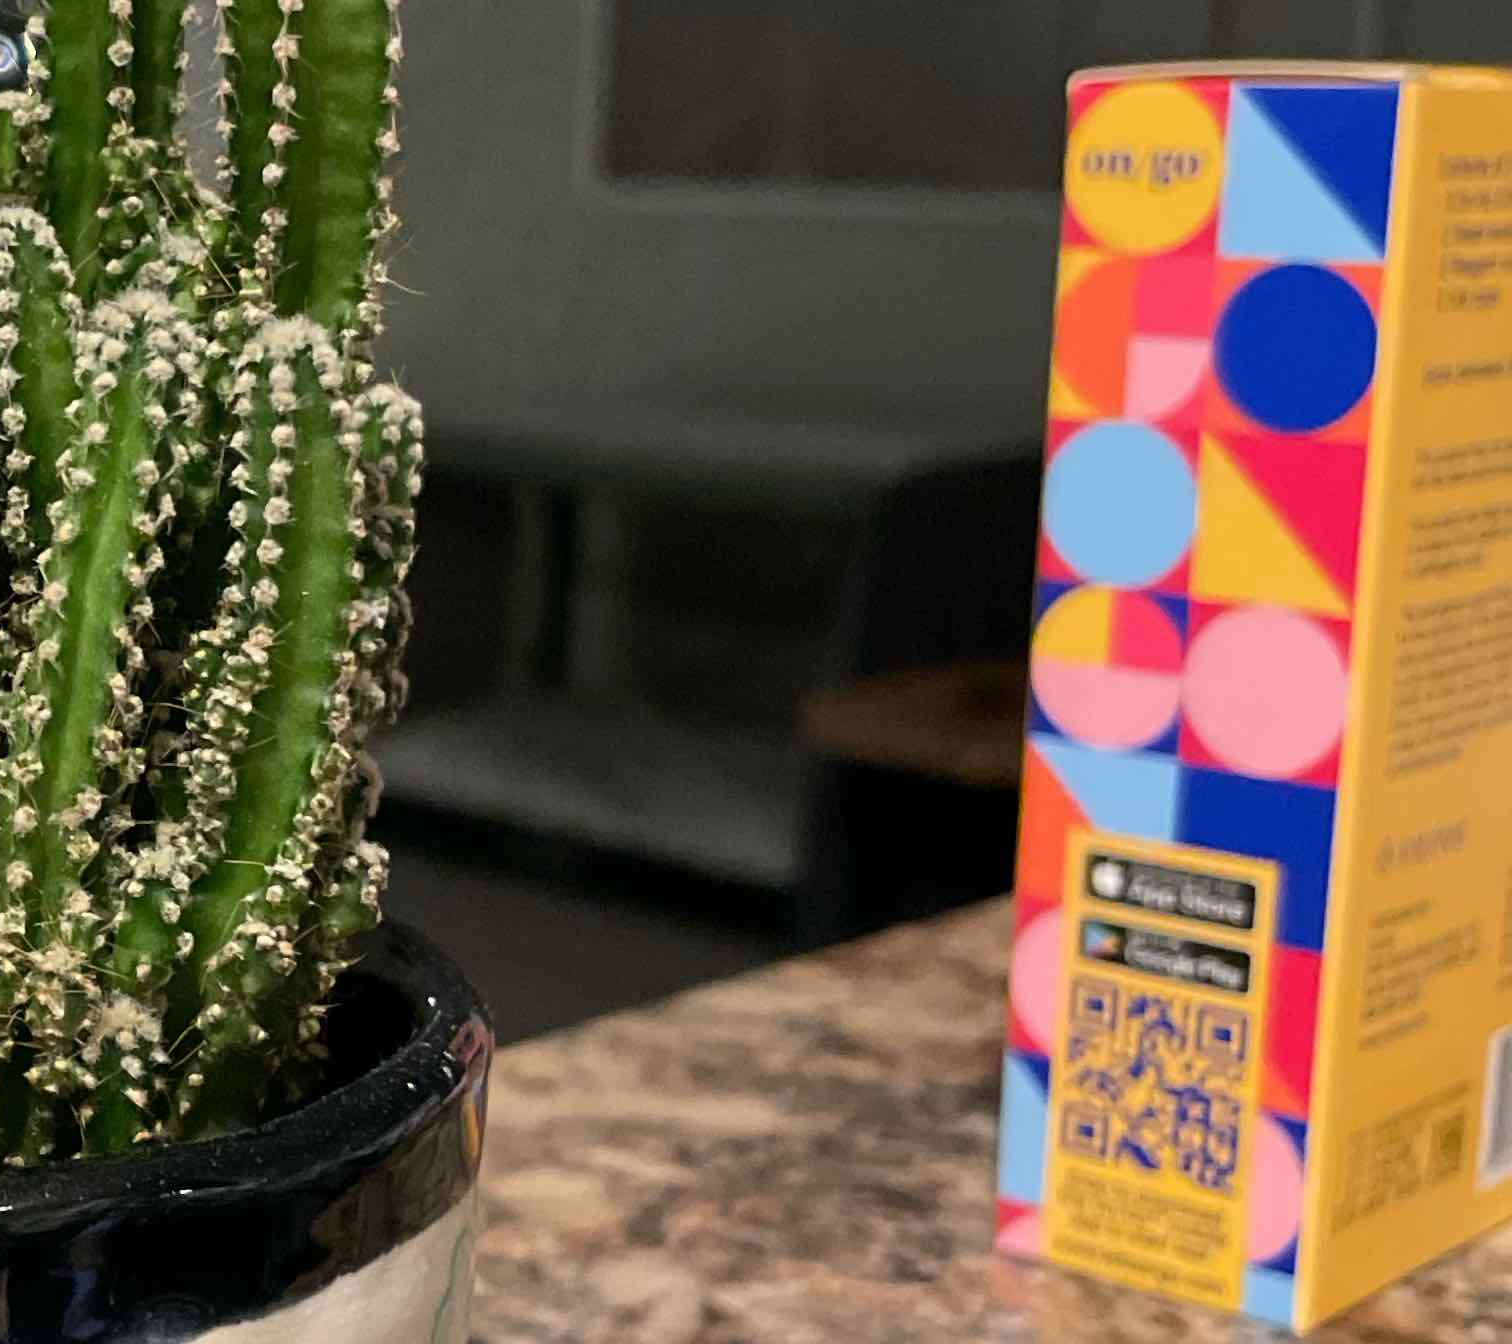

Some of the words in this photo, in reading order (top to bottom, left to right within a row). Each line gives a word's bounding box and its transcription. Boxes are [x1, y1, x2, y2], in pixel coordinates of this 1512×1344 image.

[1128, 877, 1177, 911] App
[1181, 884, 1249, 924] Store
[1125, 942, 1194, 976] Google
[1198, 955, 1242, 988] Play
